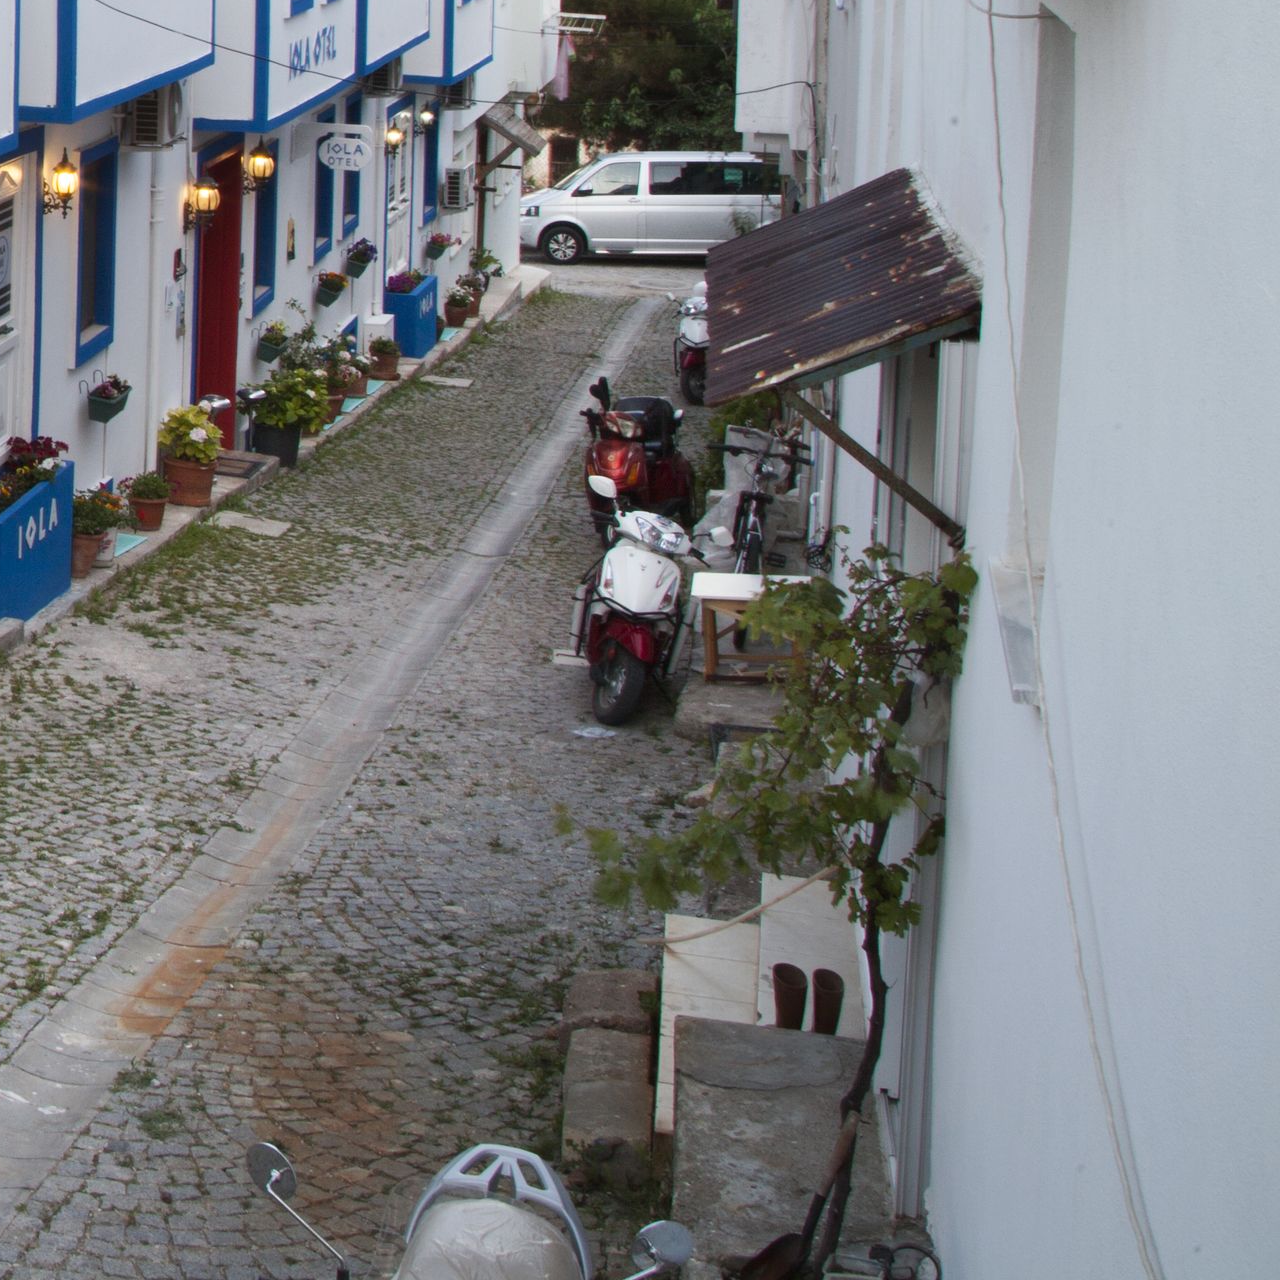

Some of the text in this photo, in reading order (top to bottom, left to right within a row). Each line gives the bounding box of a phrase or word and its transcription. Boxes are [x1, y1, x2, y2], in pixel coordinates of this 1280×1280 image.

[289, 24, 336, 81] IOLA OTEL
[327, 142, 364, 156] IOLA
[328, 156, 360, 168] OTEL
[18, 498, 59, 559] IOLA
